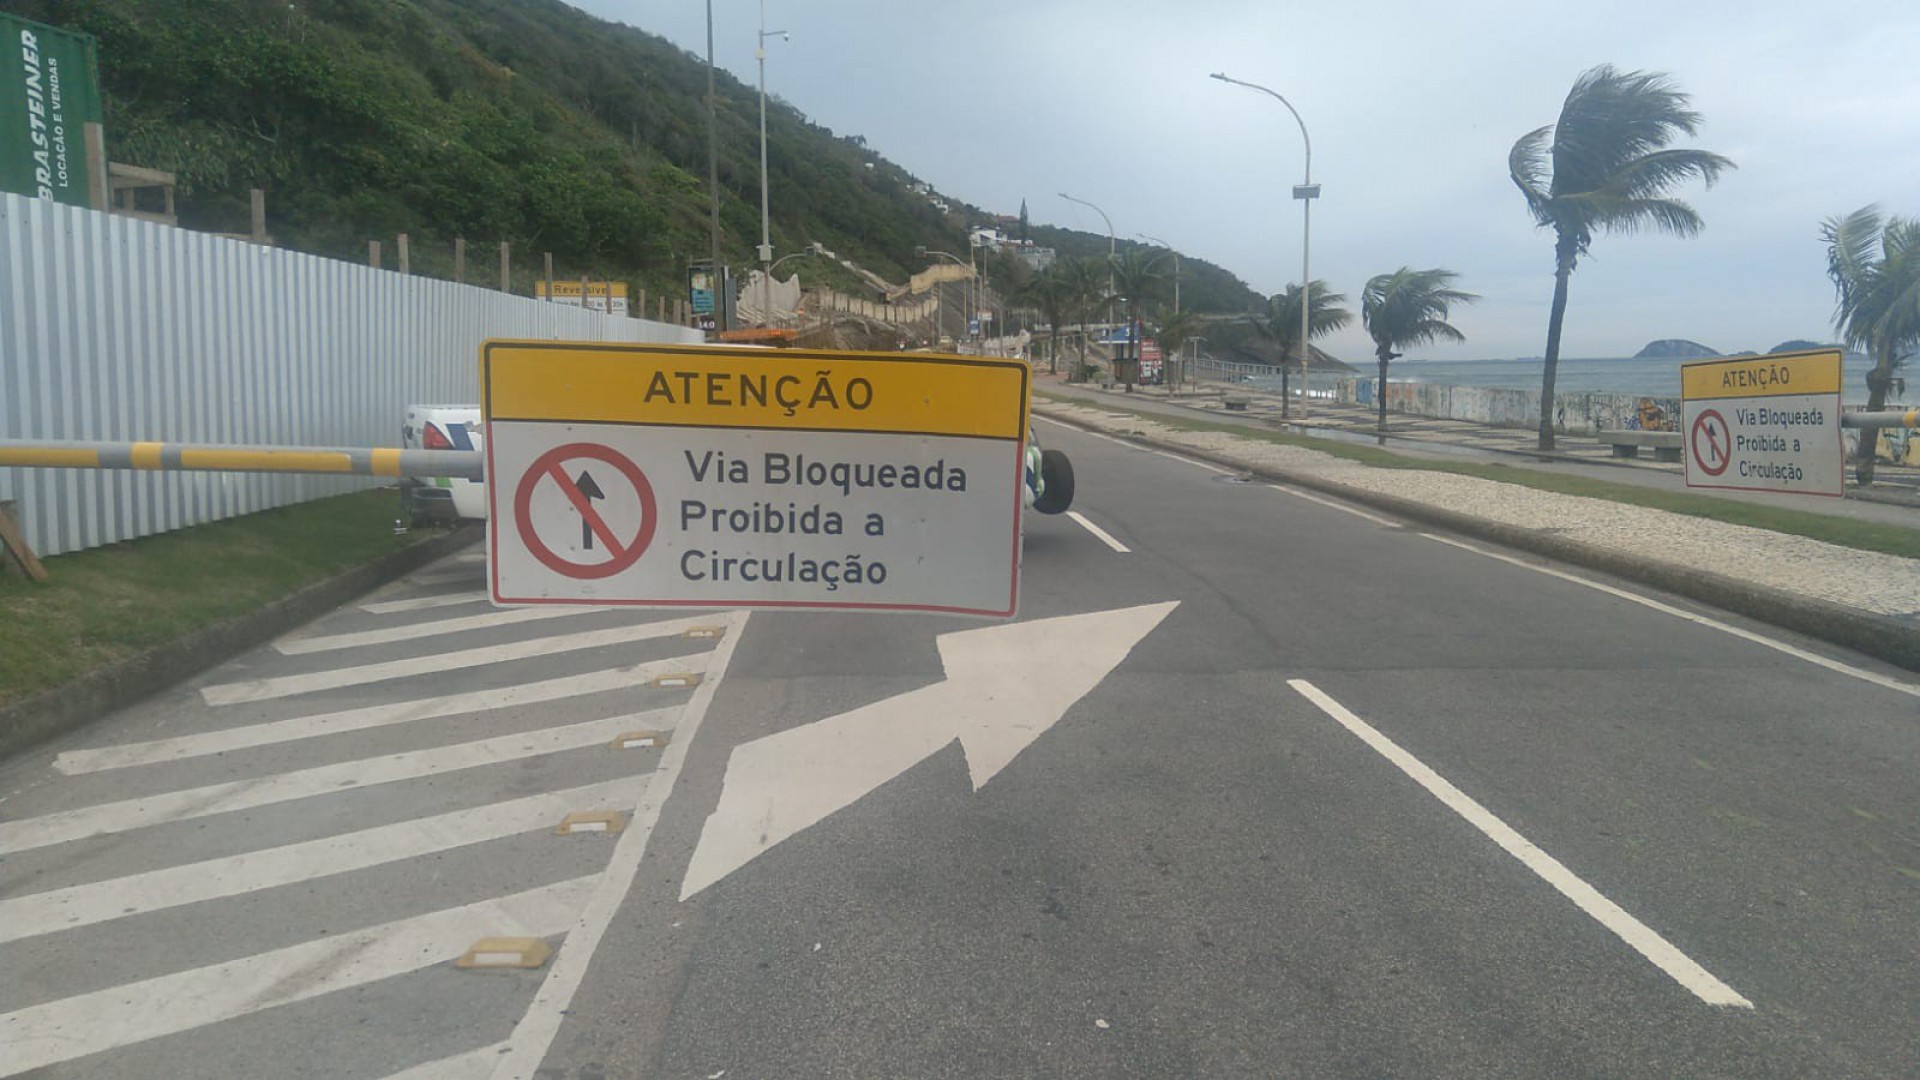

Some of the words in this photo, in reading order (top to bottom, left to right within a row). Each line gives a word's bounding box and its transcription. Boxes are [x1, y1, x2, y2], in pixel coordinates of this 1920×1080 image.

[48, 57, 61, 110] VENDAS
[53, 114, 62, 122] E
[52, 126, 68, 187] LOCAÇÃO
[643, 370, 874, 416] ATENÇÃO
[1722, 364, 1790, 389] ATENÇÃO
[1736, 408, 1756, 426] Via
[1759, 407, 1824, 430] Bloqueada
[1736, 435, 1786, 452] Proibida
[1793, 439, 1801, 452] a
[683, 449, 749, 484] Via
[764, 453, 968, 497] Bloqueada
[1739, 460, 1803, 484] Circulação
[680, 500, 843, 536] Proibida
[864, 509, 885, 536] a
[680, 550, 888, 591] Circulação
